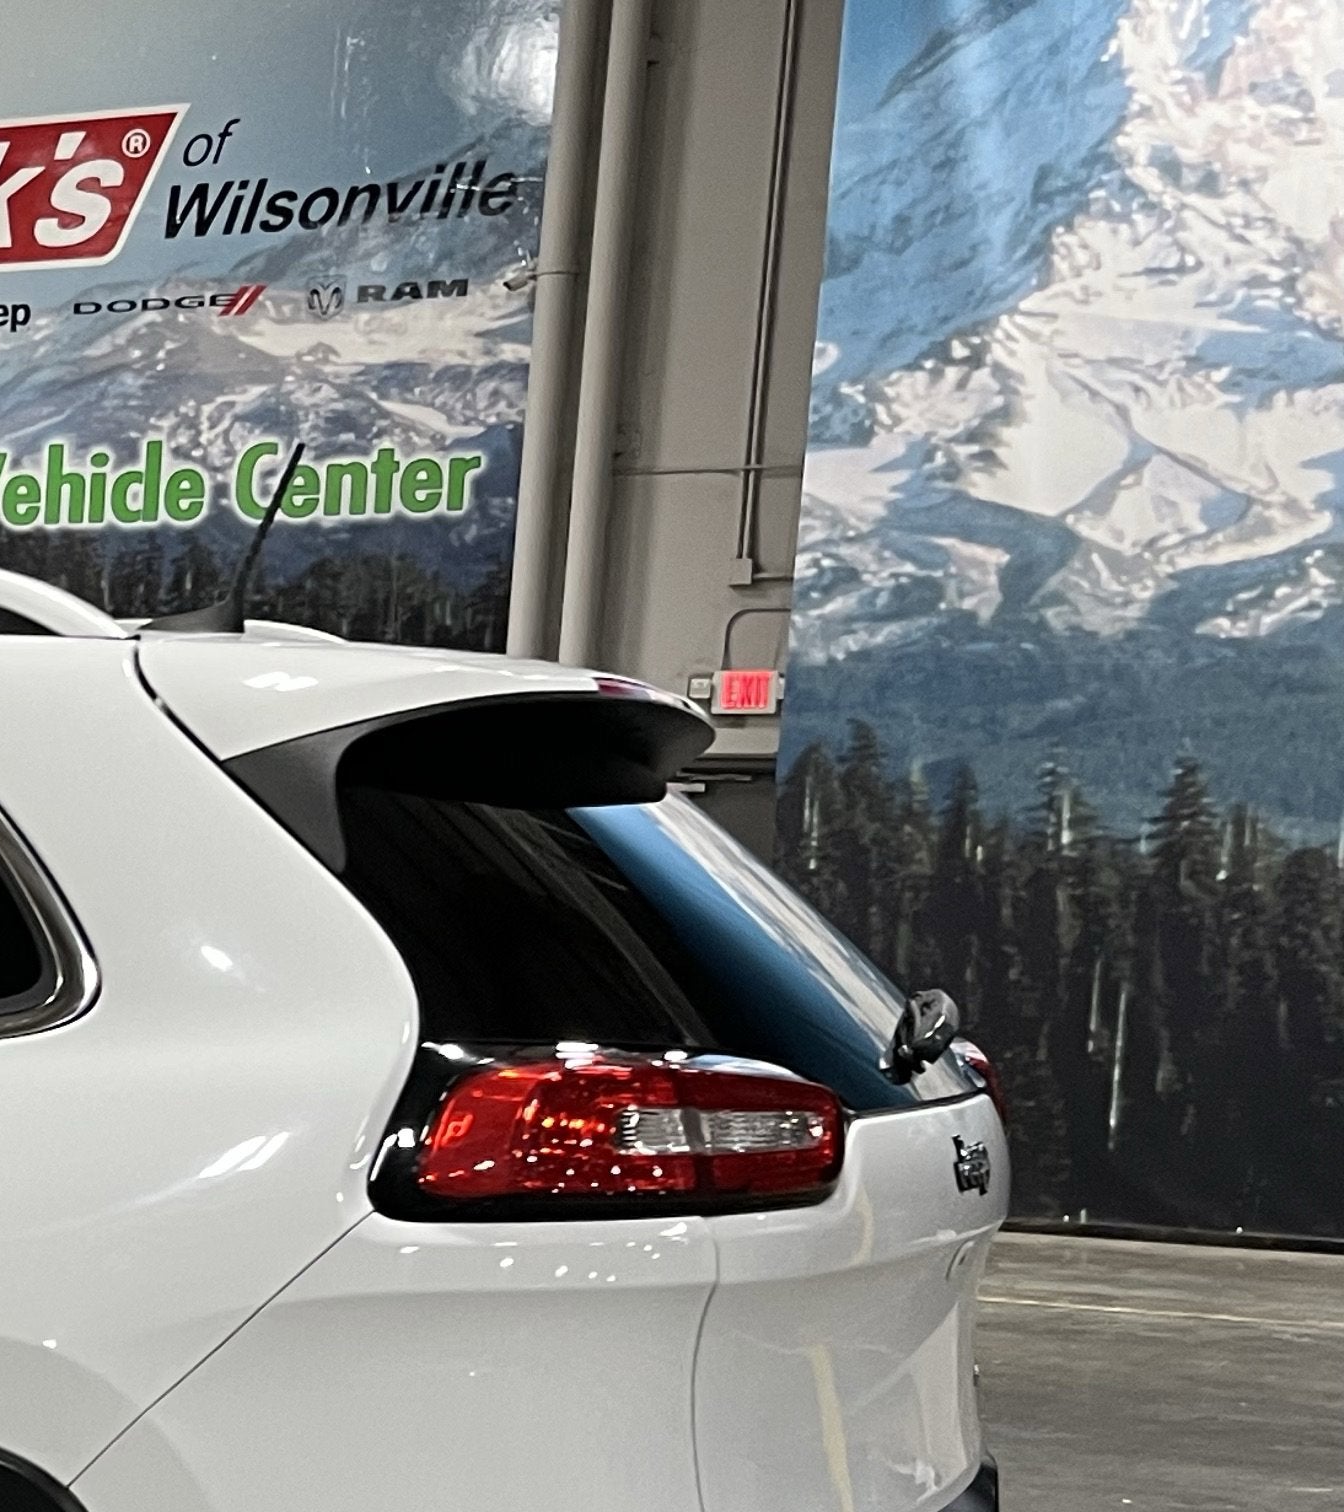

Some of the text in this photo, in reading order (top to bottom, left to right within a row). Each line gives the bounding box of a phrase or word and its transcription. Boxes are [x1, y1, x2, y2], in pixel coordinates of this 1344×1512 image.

[182, 118, 242, 167] of
[164, 160, 517, 239] Wilsonville
[72, 292, 237, 315] DODGE
[356, 278, 469, 304] RAM
[234, 442, 482, 520] Center
[723, 674, 769, 708] EXIT
